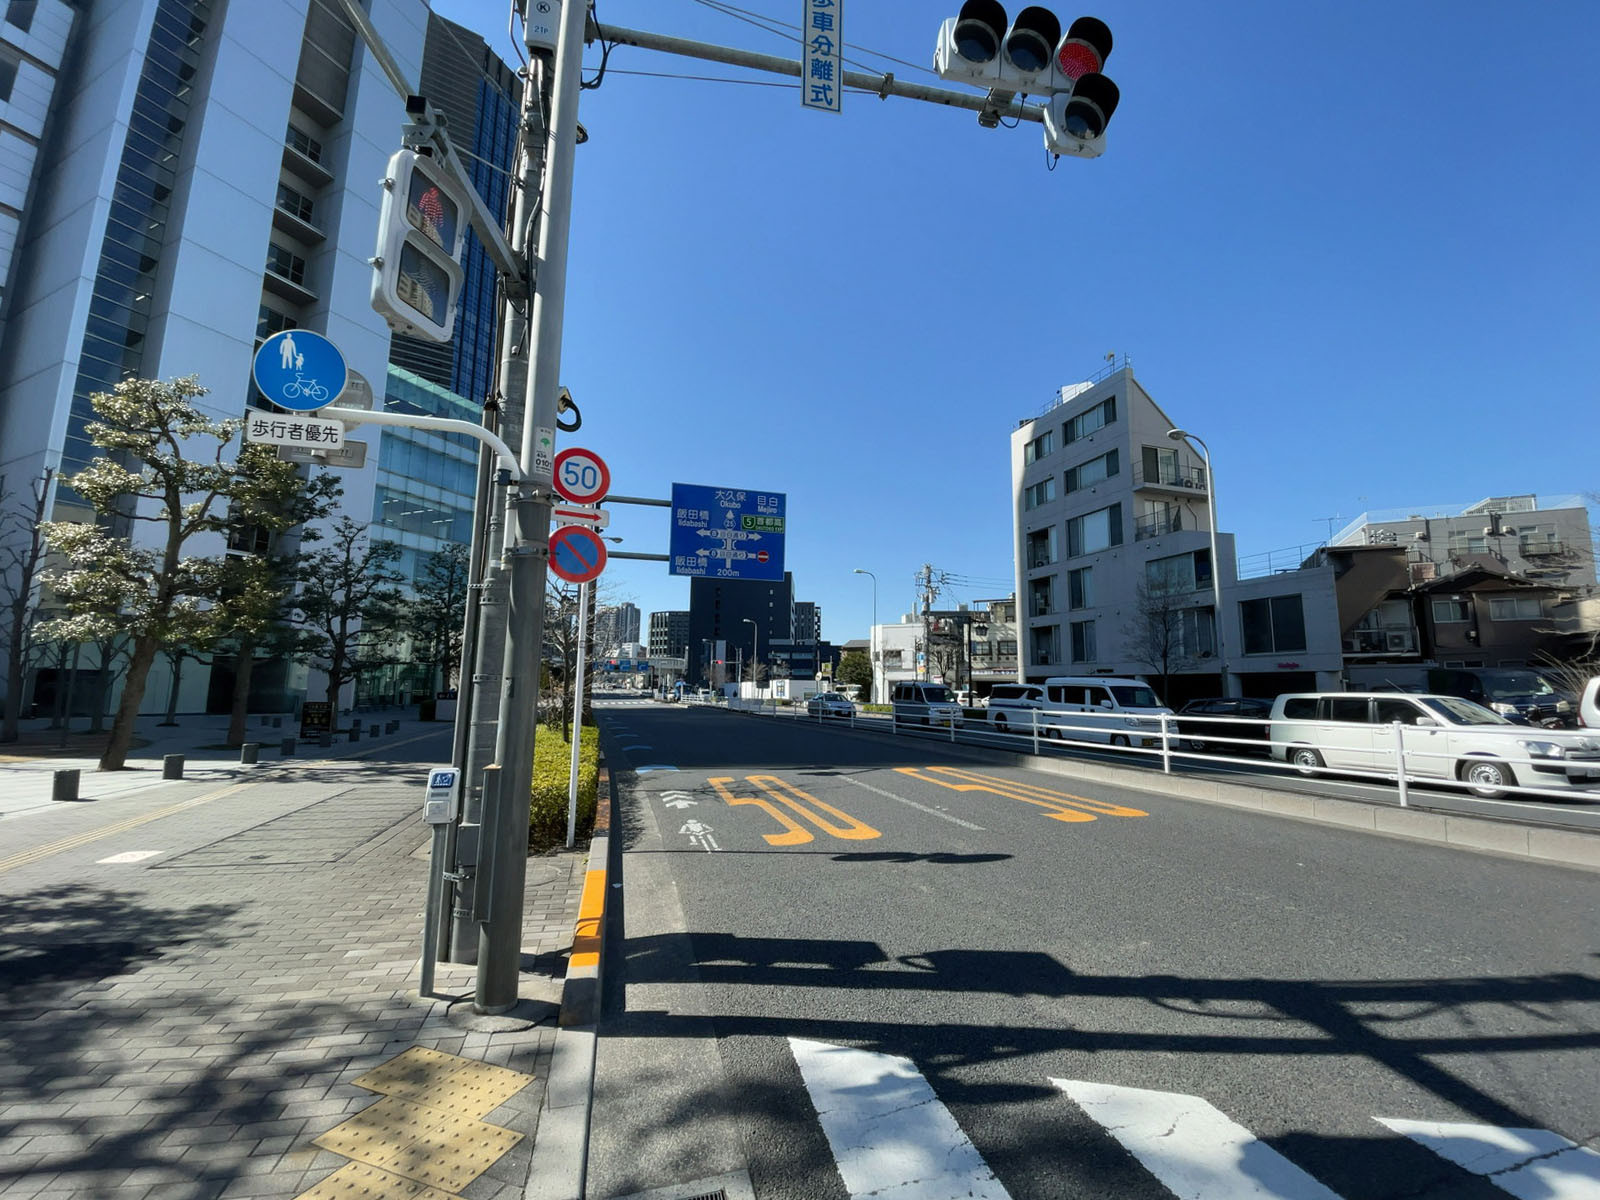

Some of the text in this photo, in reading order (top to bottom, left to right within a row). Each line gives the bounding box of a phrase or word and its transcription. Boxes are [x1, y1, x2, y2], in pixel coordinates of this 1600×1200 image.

[252, 420, 339, 444] 歩行者優先
[564, 461, 597, 490] 50
[715, 490, 747, 502] 大久保
[757, 496, 778, 507] 目白
[676, 508, 710, 521] 飯田橋
[757, 505, 778, 514] Mejiro
[677, 519, 708, 528] Iidabashi
[745, 518, 752, 526] 5
[675, 555, 708, 567] 飯田橋
[676, 566, 706, 575] Iidabashi
[717, 568, 740, 577] 200m
[891, 766, 1150, 823] 50
[707, 775, 882, 847] 50
